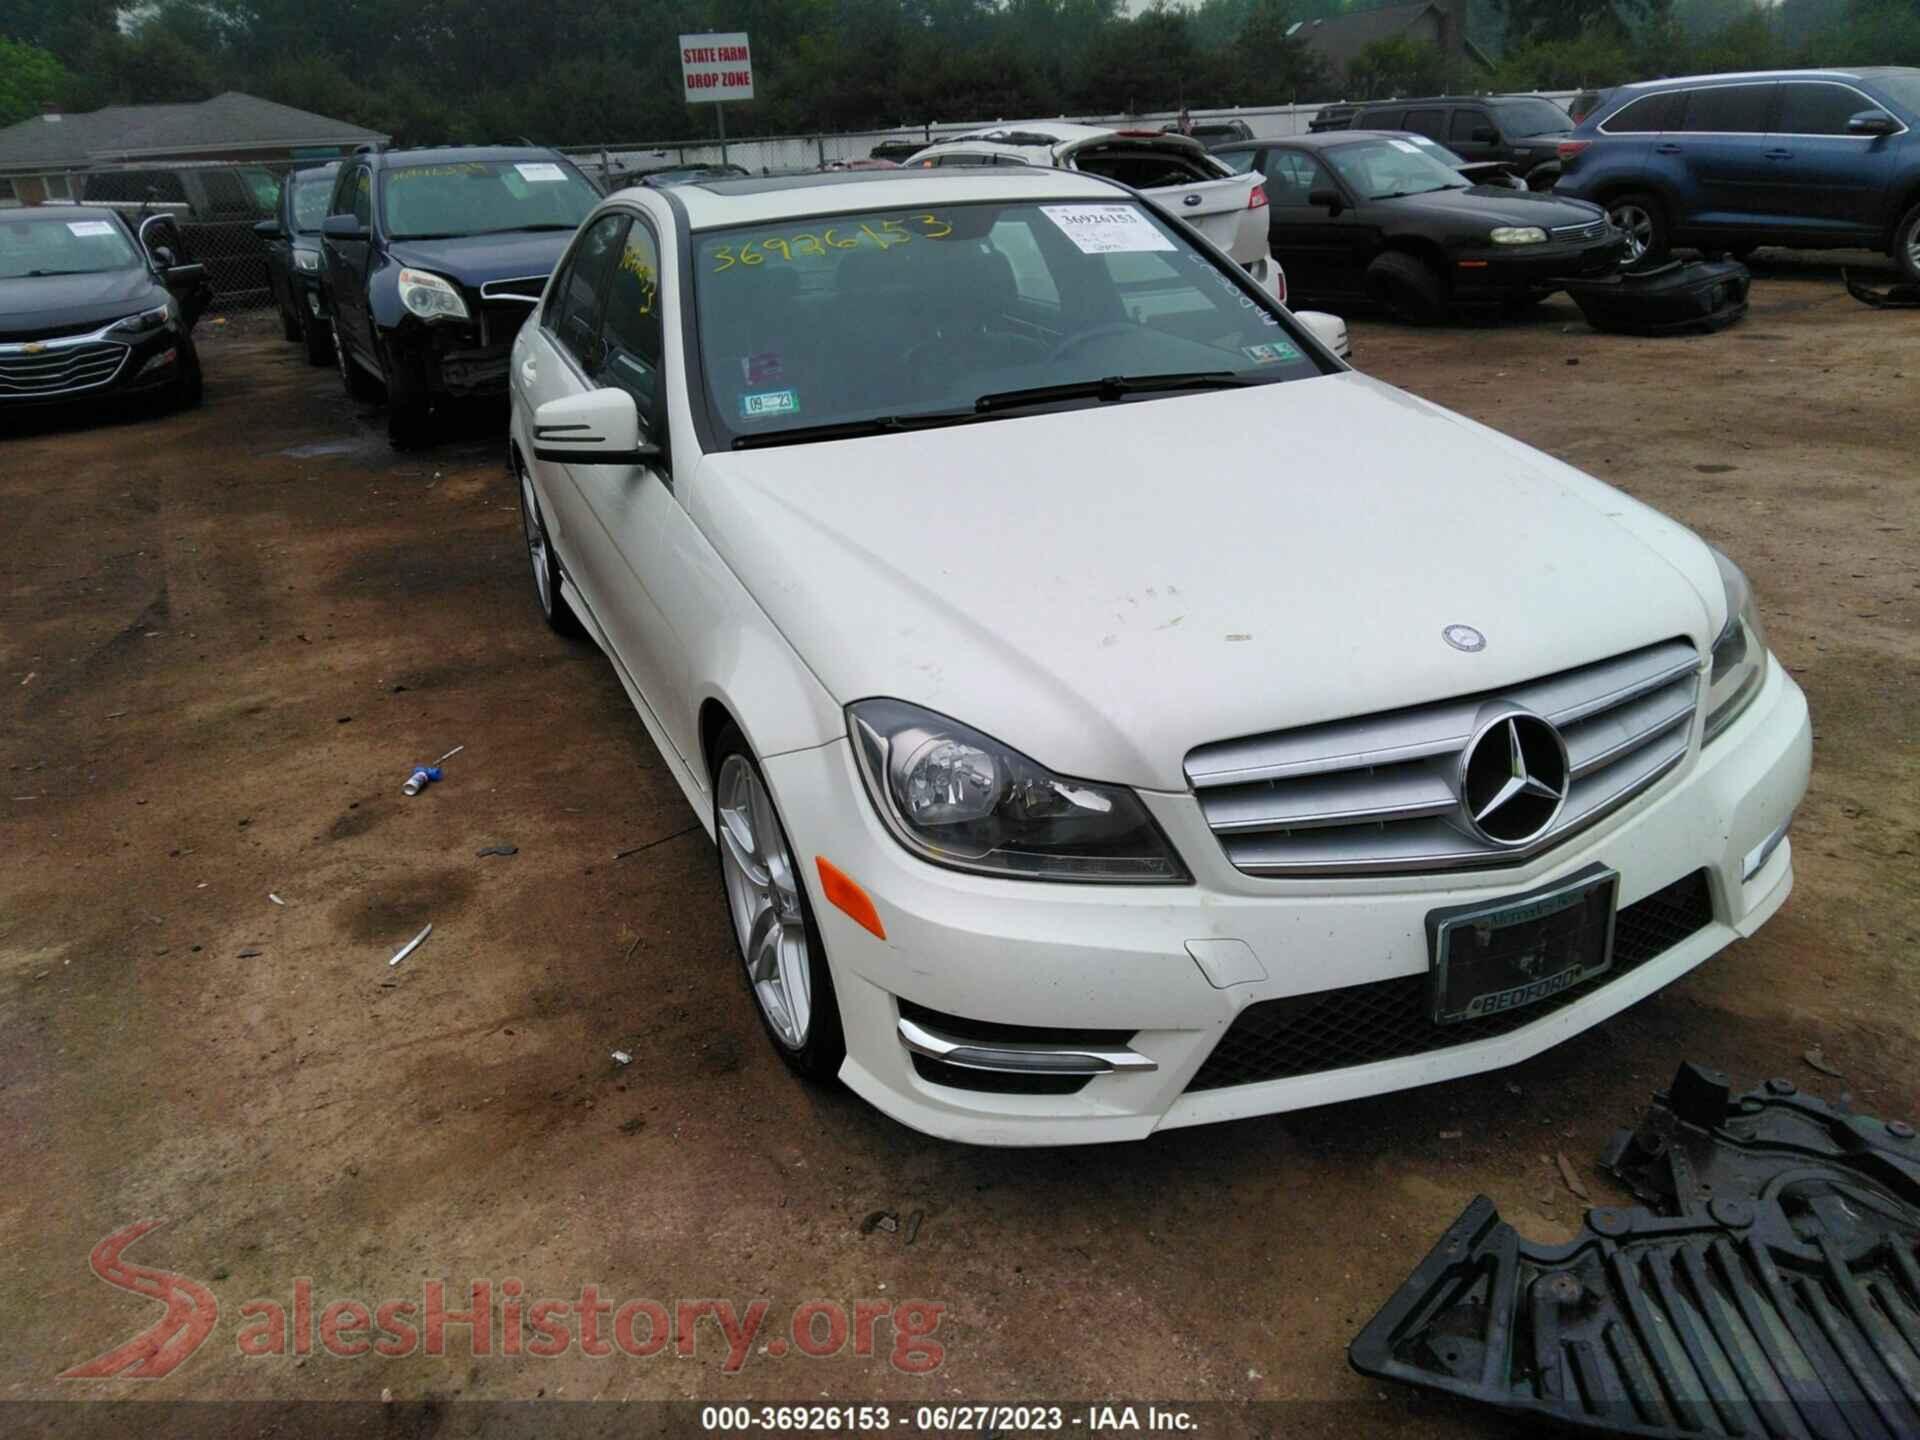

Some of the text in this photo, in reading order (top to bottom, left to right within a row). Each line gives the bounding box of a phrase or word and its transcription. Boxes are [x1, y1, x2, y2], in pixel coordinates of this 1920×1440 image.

[683, 45, 748, 64] STATE FARM
[687, 71, 751, 89] DROP ZONE
[713, 213, 952, 273] 36926153
